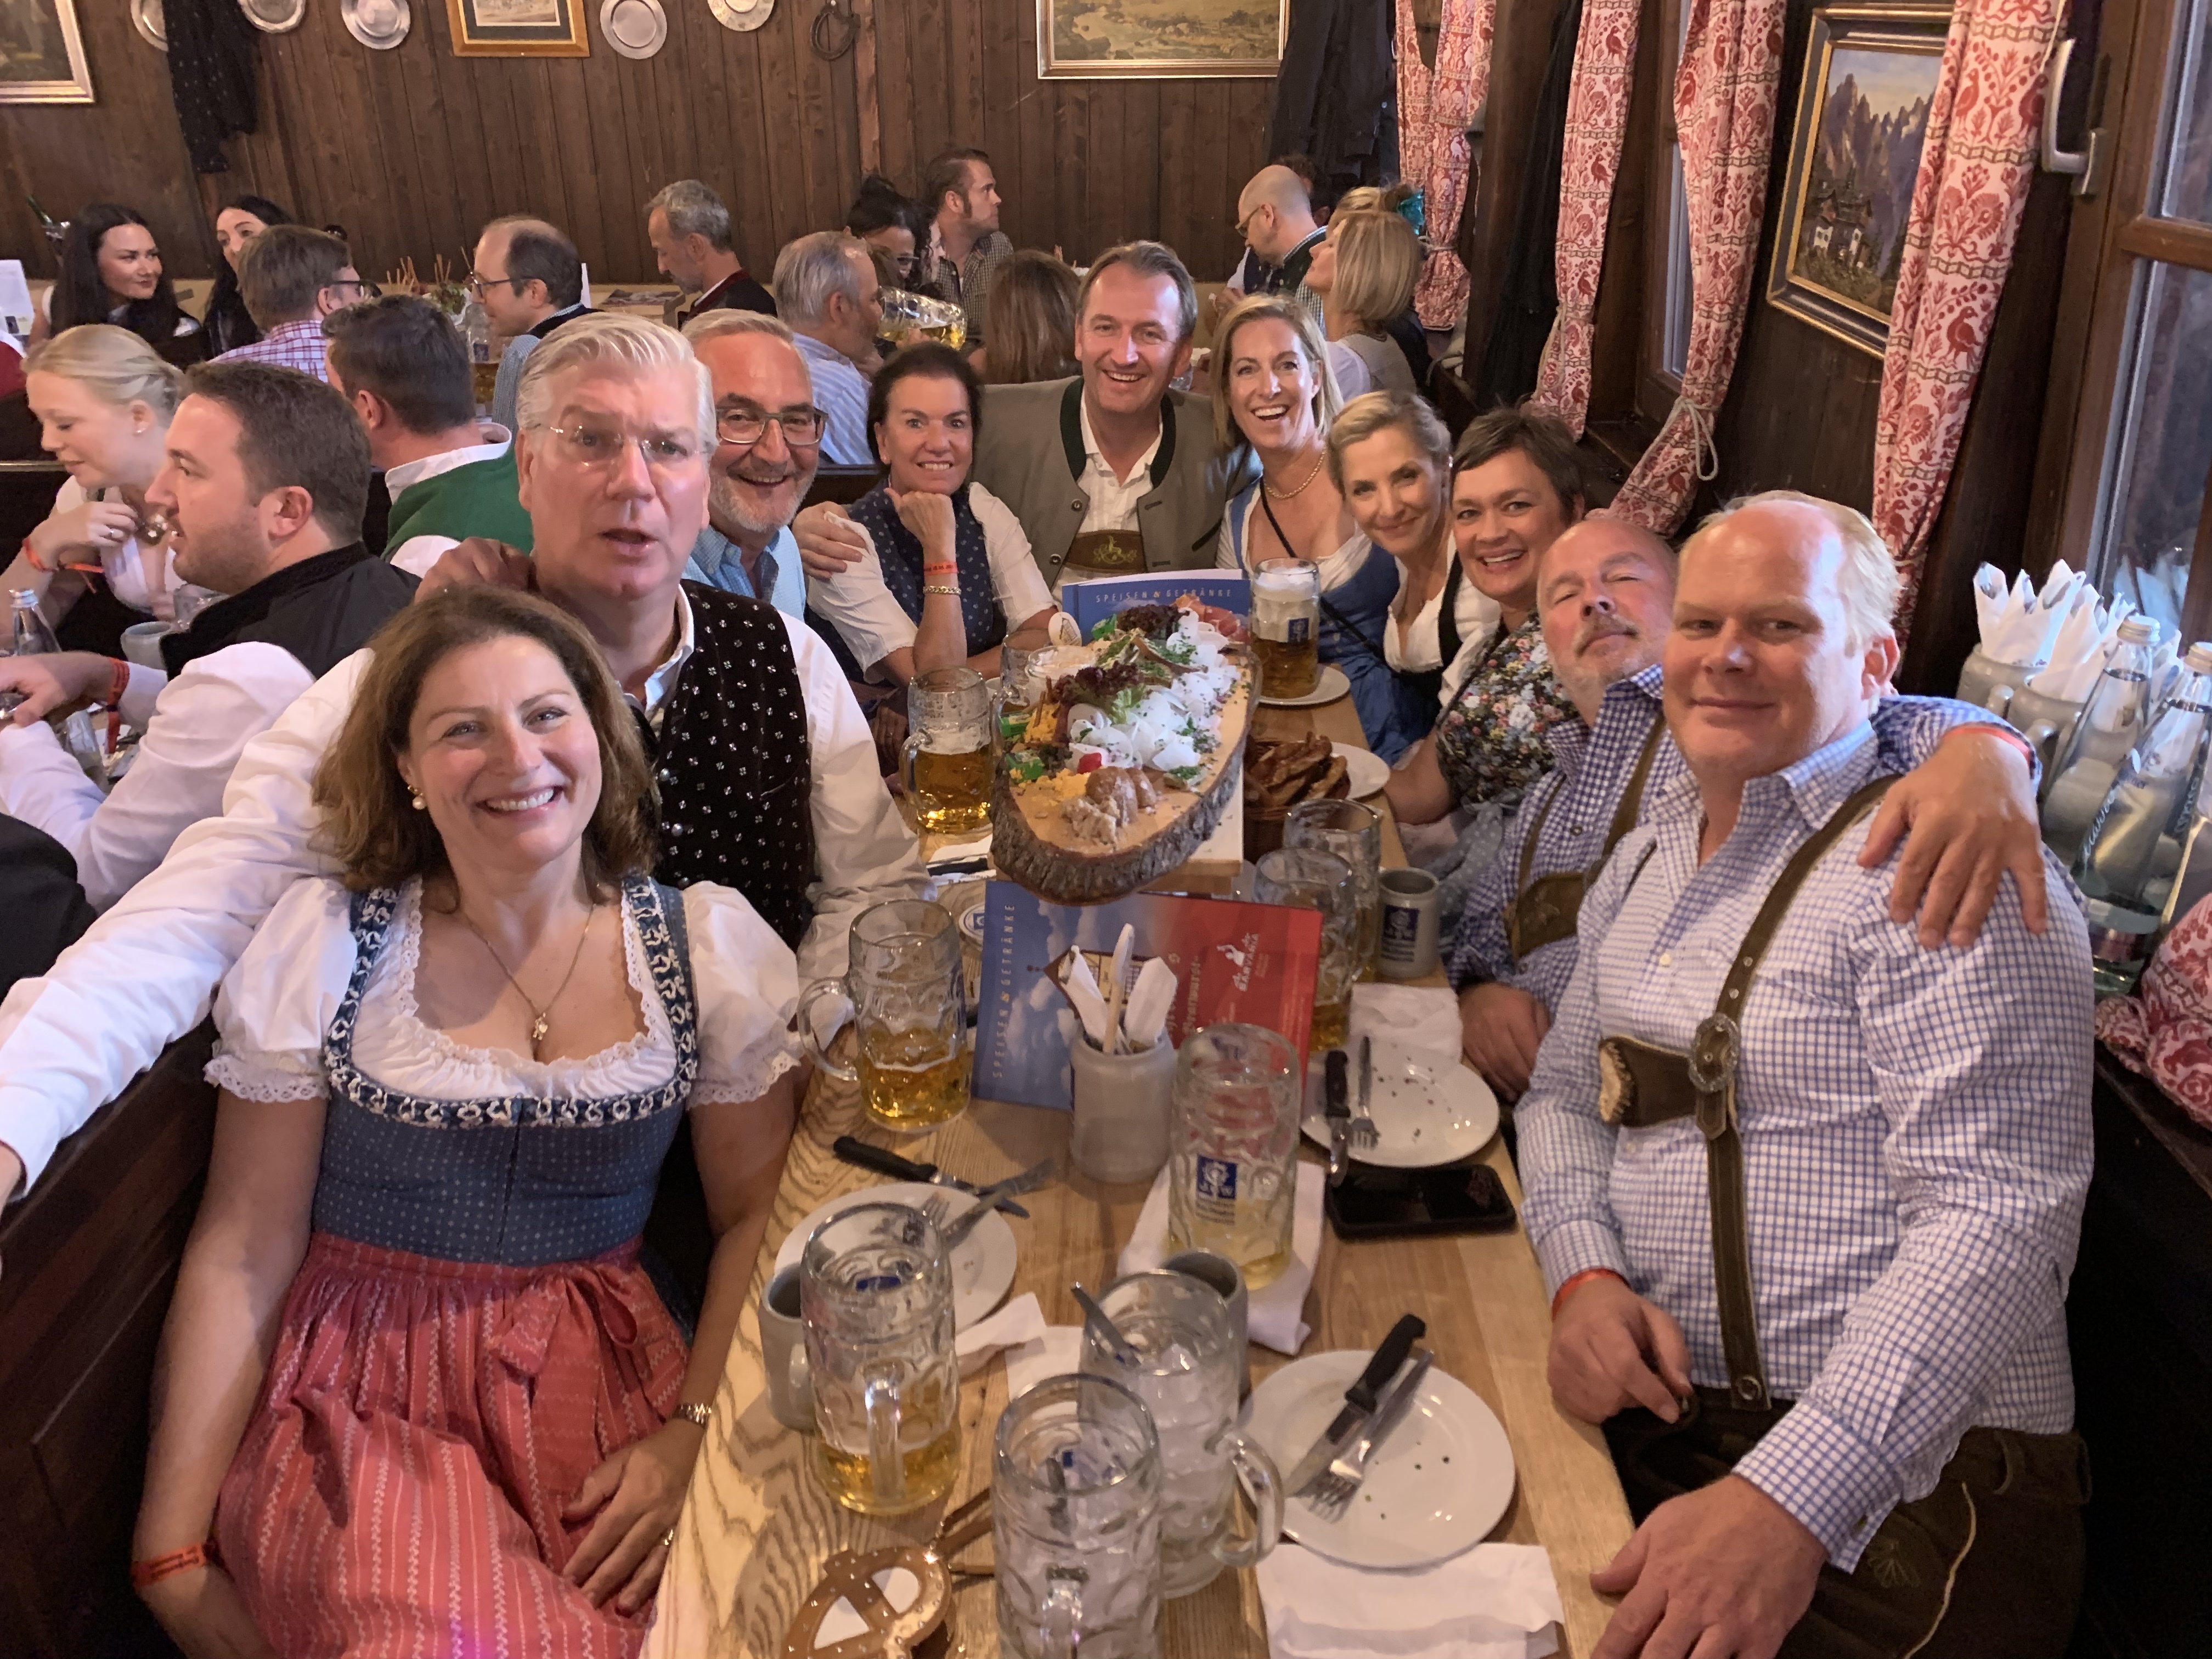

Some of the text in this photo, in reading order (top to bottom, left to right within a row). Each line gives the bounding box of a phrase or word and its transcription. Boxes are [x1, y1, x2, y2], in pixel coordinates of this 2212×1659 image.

[1096, 591, 1148, 603] SPEISEN
[1166, 587, 1231, 598] GETRÄNKE
[992, 1009, 1008, 1079] SPEISEN
[1001, 905, 1015, 986] GETRÄNKE
